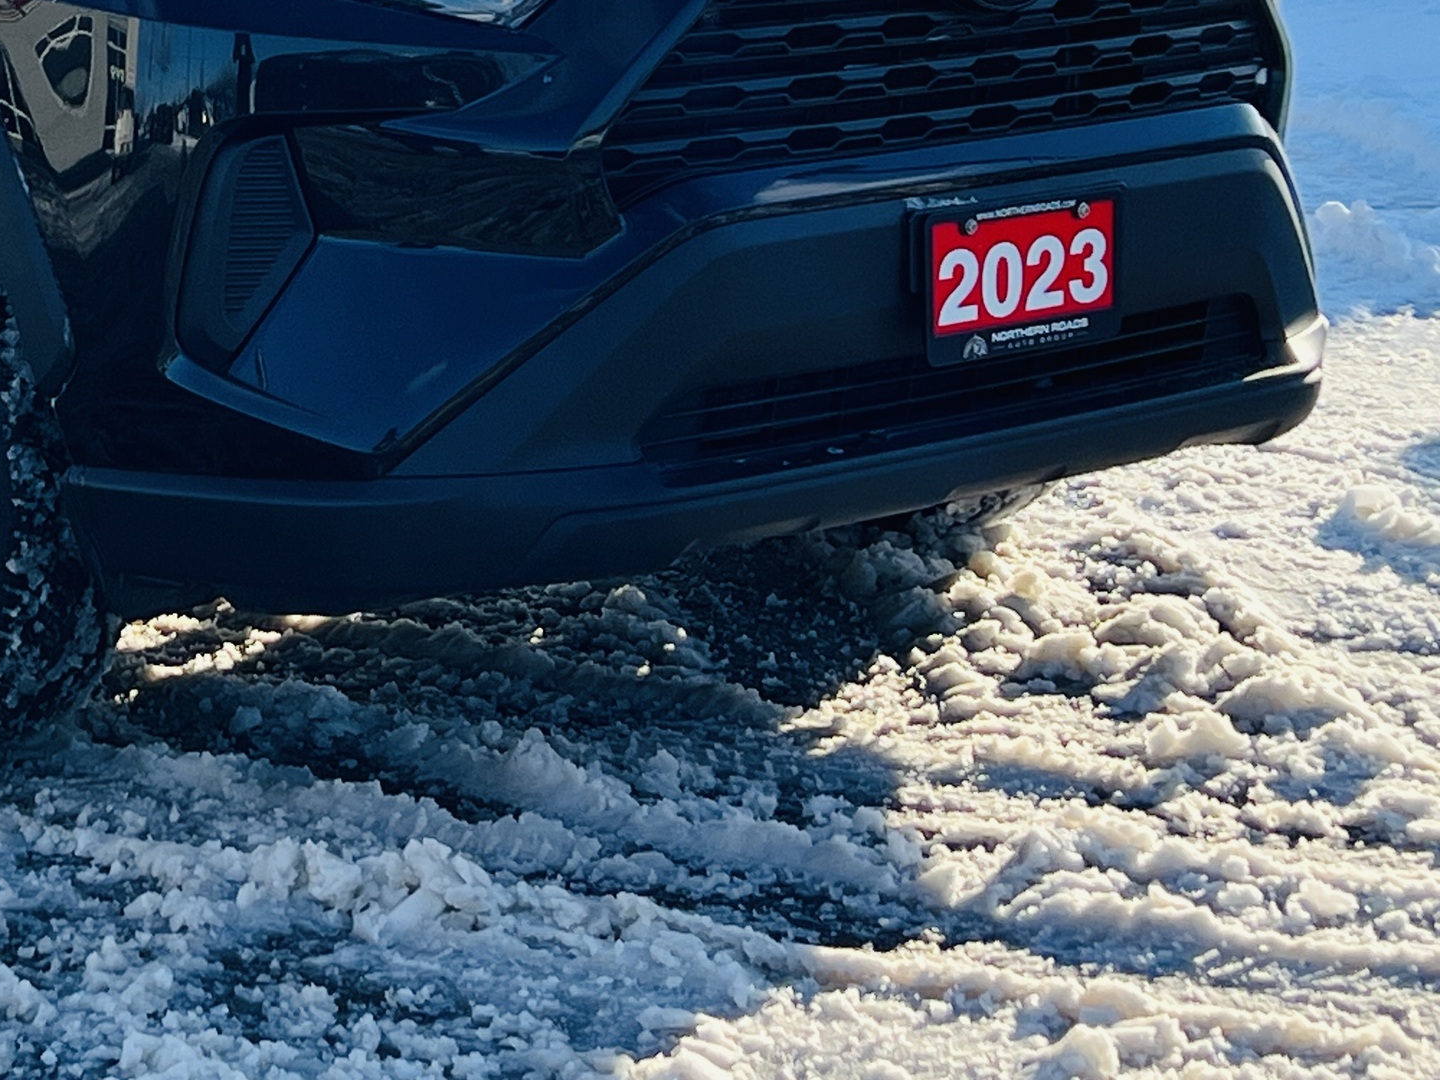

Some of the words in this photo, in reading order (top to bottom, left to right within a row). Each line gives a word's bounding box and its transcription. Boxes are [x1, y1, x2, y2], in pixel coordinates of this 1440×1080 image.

[938, 228, 1109, 327] 2023
[991, 324, 1050, 342] NORTHERN
[1050, 317, 1089, 332] ROADS
